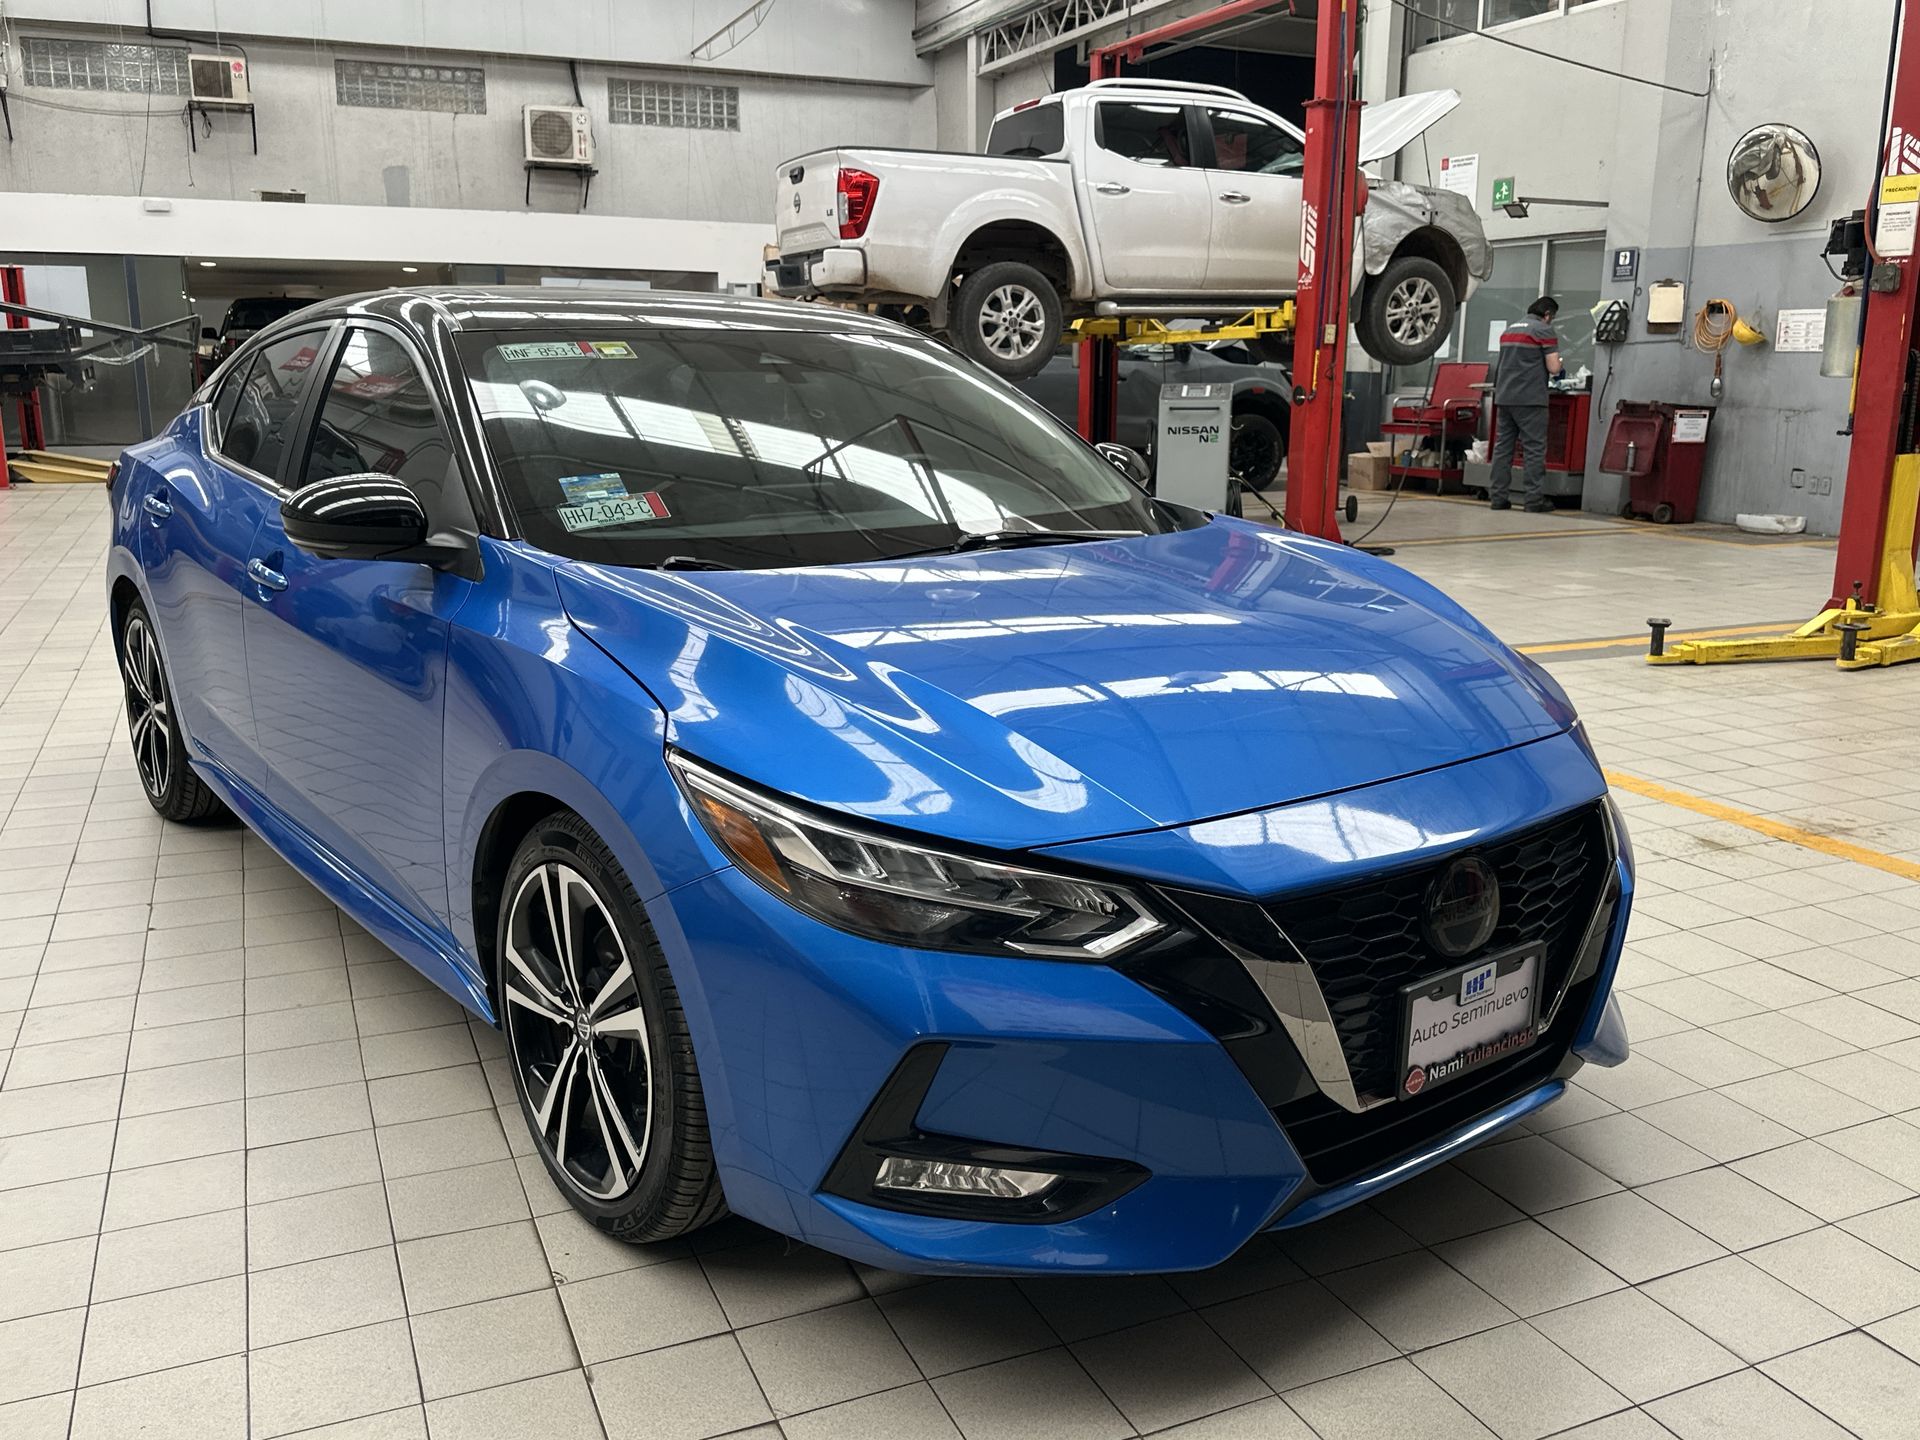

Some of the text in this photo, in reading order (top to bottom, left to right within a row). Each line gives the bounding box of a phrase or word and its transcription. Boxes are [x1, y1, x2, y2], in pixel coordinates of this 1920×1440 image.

[826, 208, 834, 216] LE
[504, 347, 583, 359] HNF-853-C
[1167, 425, 1219, 435] NISSAN
[1199, 434, 1219, 443] N2
[563, 500, 651, 525] HHZ-043-C
[1411, 986, 1529, 1046] Auto Seminuevo
[1429, 1029, 1533, 1082] Nami Tulancingo
